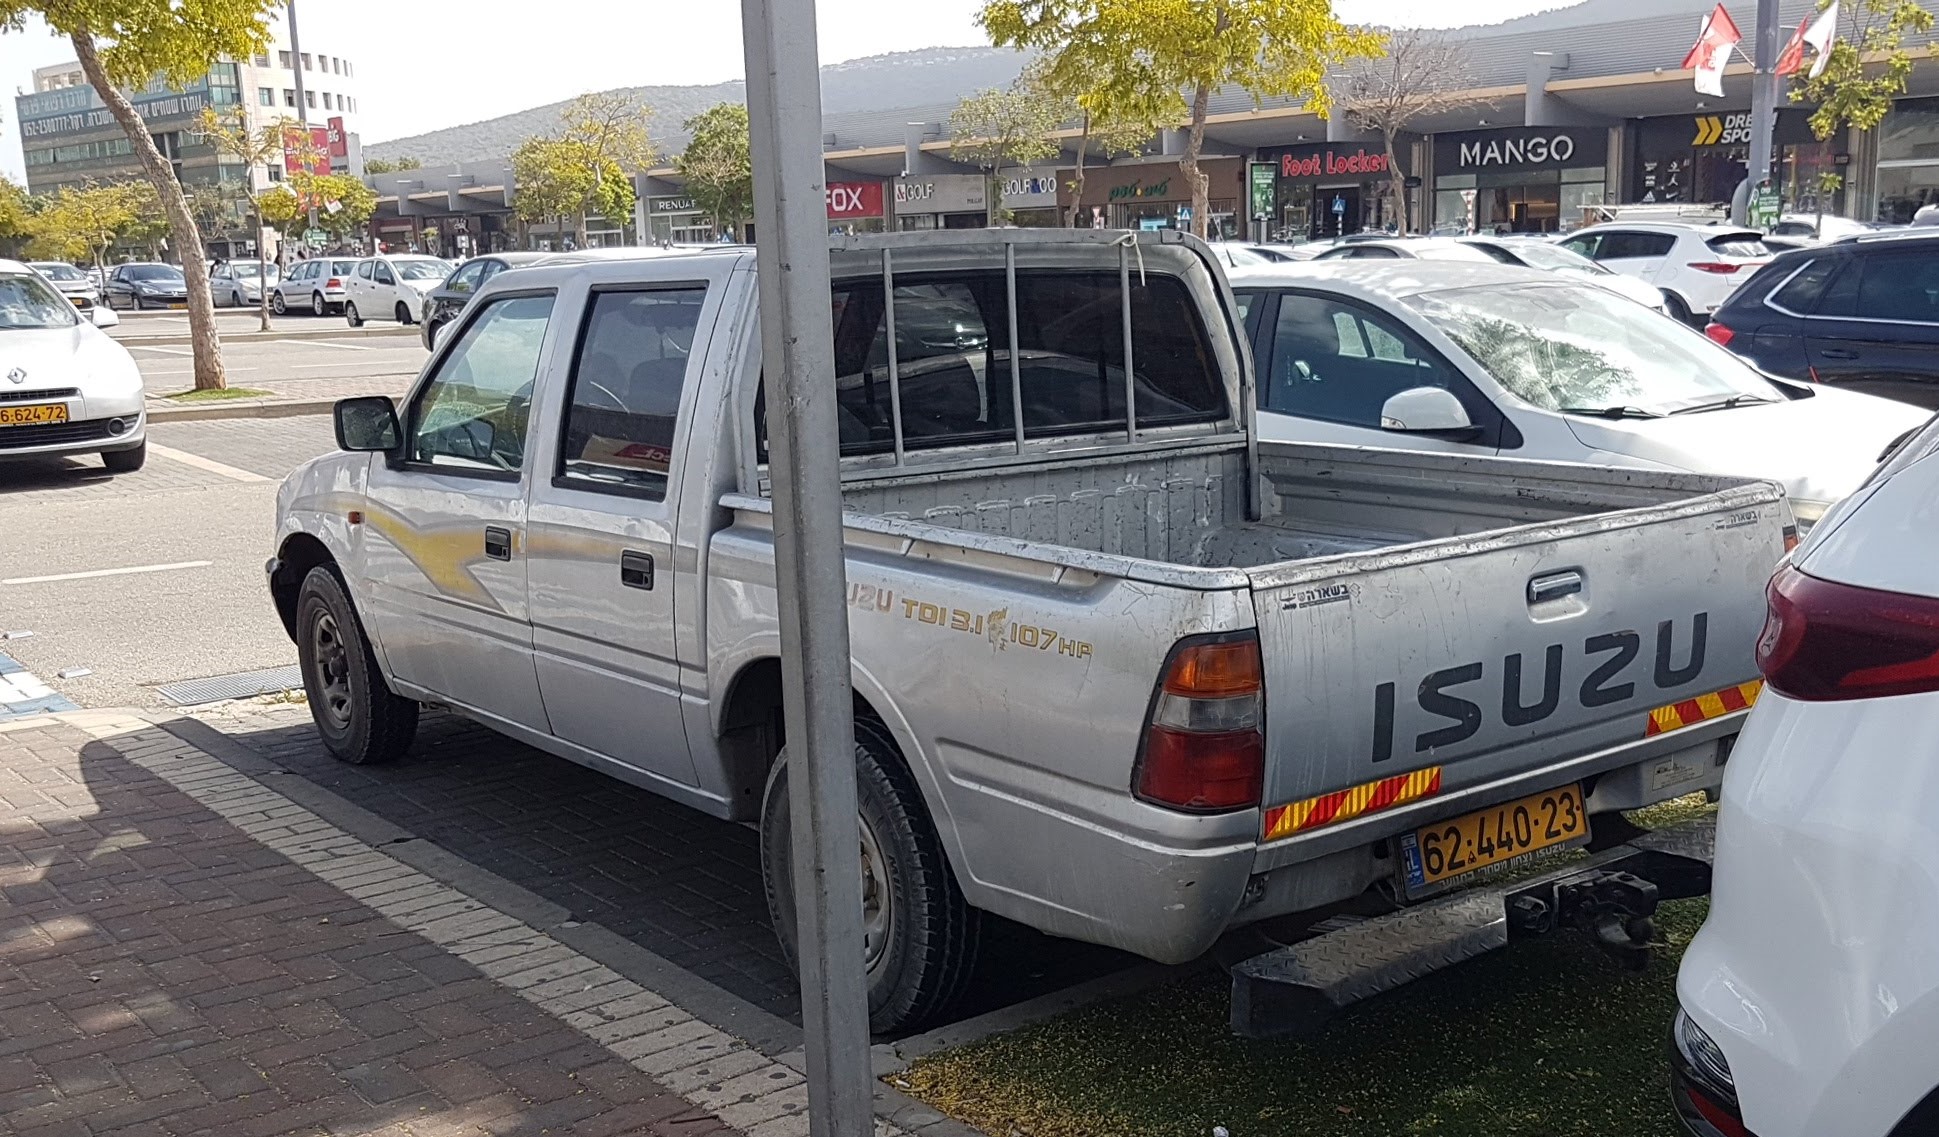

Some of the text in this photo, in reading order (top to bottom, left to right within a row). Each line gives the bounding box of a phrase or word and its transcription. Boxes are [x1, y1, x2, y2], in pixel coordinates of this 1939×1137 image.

[151, 98, 179, 117] שטחים
[1460, 135, 1574, 168] MANGO
[1282, 149, 1388, 177] Foot Locker
[907, 184, 934, 199] GOLF
[1306, 584, 1349, 601] בשארה
[1372, 612, 1708, 763] ISUZU
[1536, 843, 1565, 858] ISUZU
